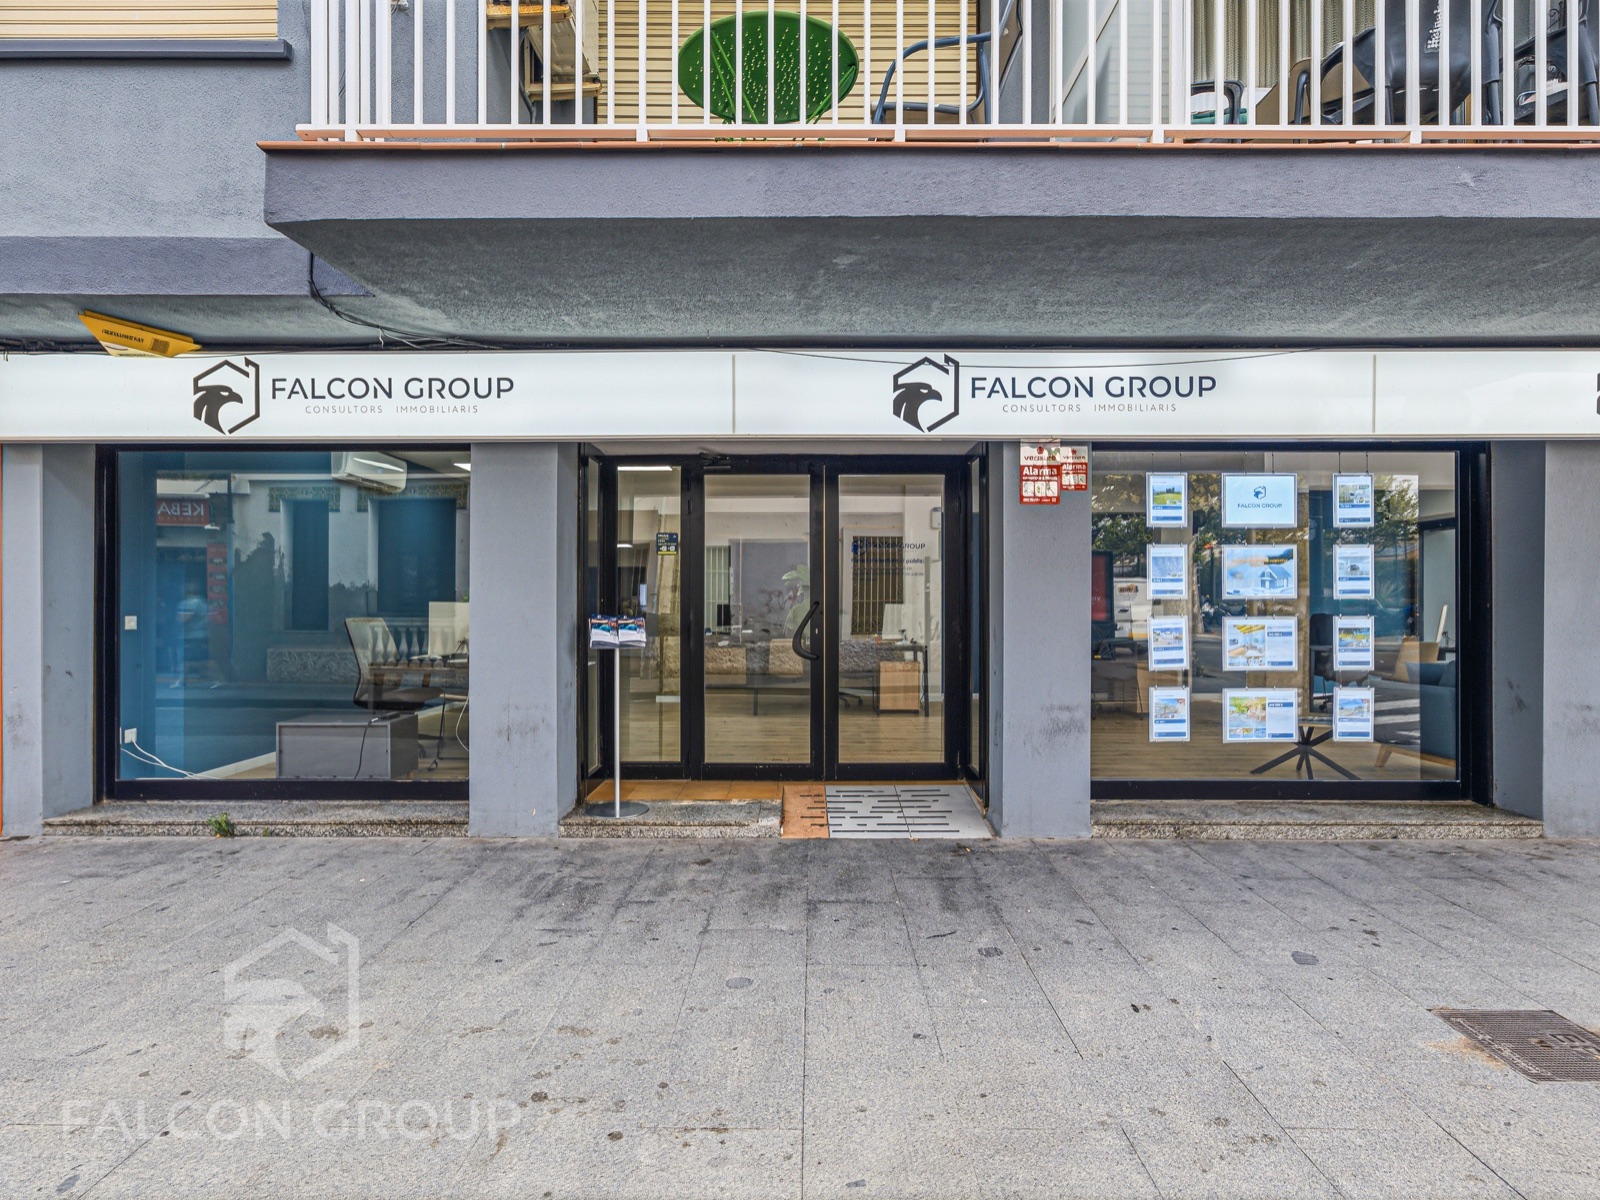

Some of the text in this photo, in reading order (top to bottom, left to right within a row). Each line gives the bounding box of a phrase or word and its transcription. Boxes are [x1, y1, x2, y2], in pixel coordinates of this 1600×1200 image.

[271, 377, 515, 400] FALCON GROUP
[971, 375, 1217, 399] FALCON GROUP
[304, 405, 479, 414] CONSULTORS IMMOBILIARIS
[1002, 403, 1177, 413] CONSULTORS IMMOBILIARIS
[1023, 466, 1058, 476] Alarma
